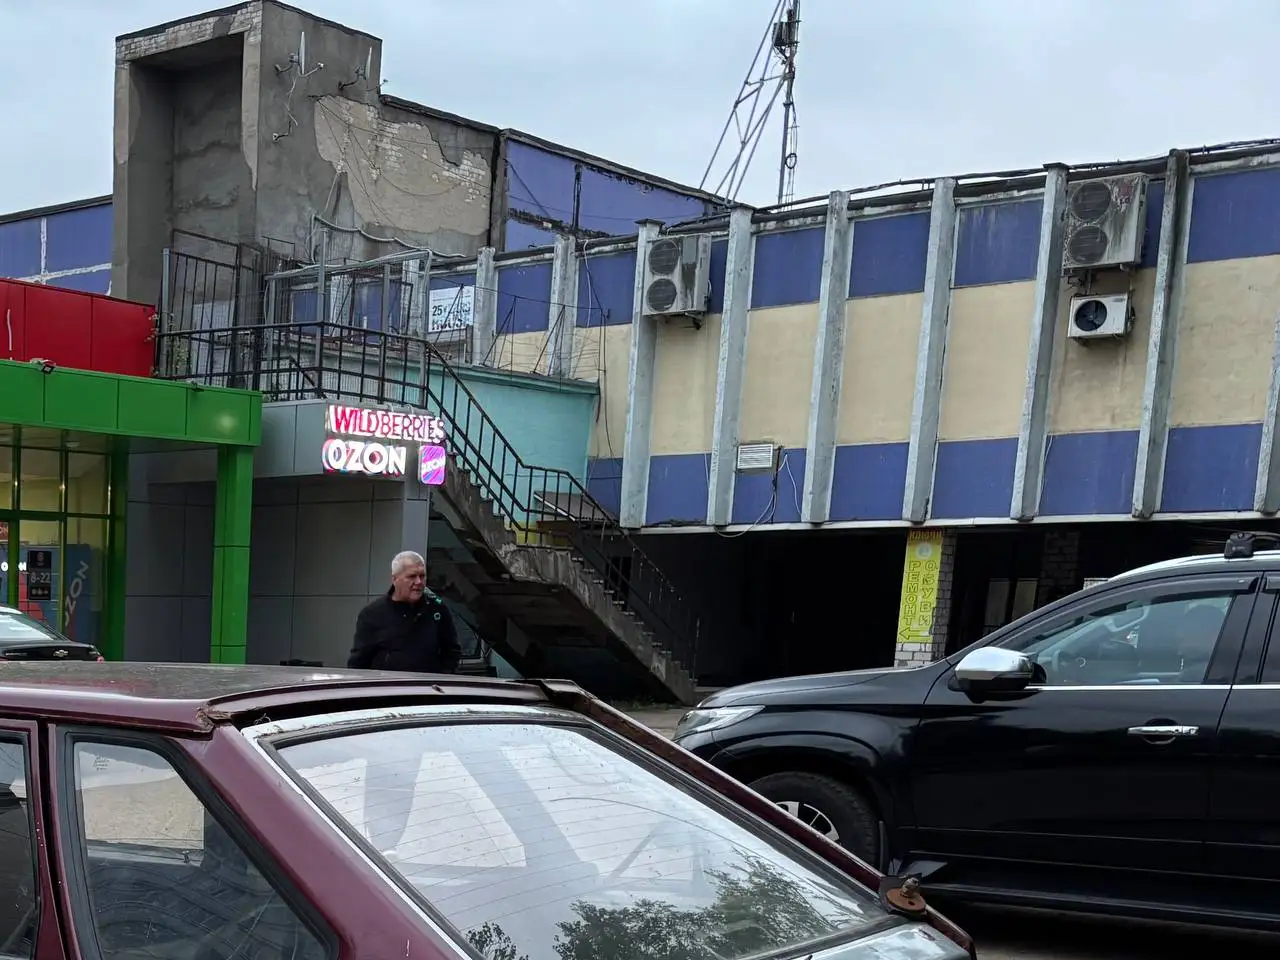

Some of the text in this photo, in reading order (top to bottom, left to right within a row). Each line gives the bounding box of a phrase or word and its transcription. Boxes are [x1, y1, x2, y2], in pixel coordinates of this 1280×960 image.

[328, 404, 445, 444] WILDBERRIES
[322, 438, 407, 475] OZON
[903, 560, 937, 626] РЕМОНТ ОБУВИ
